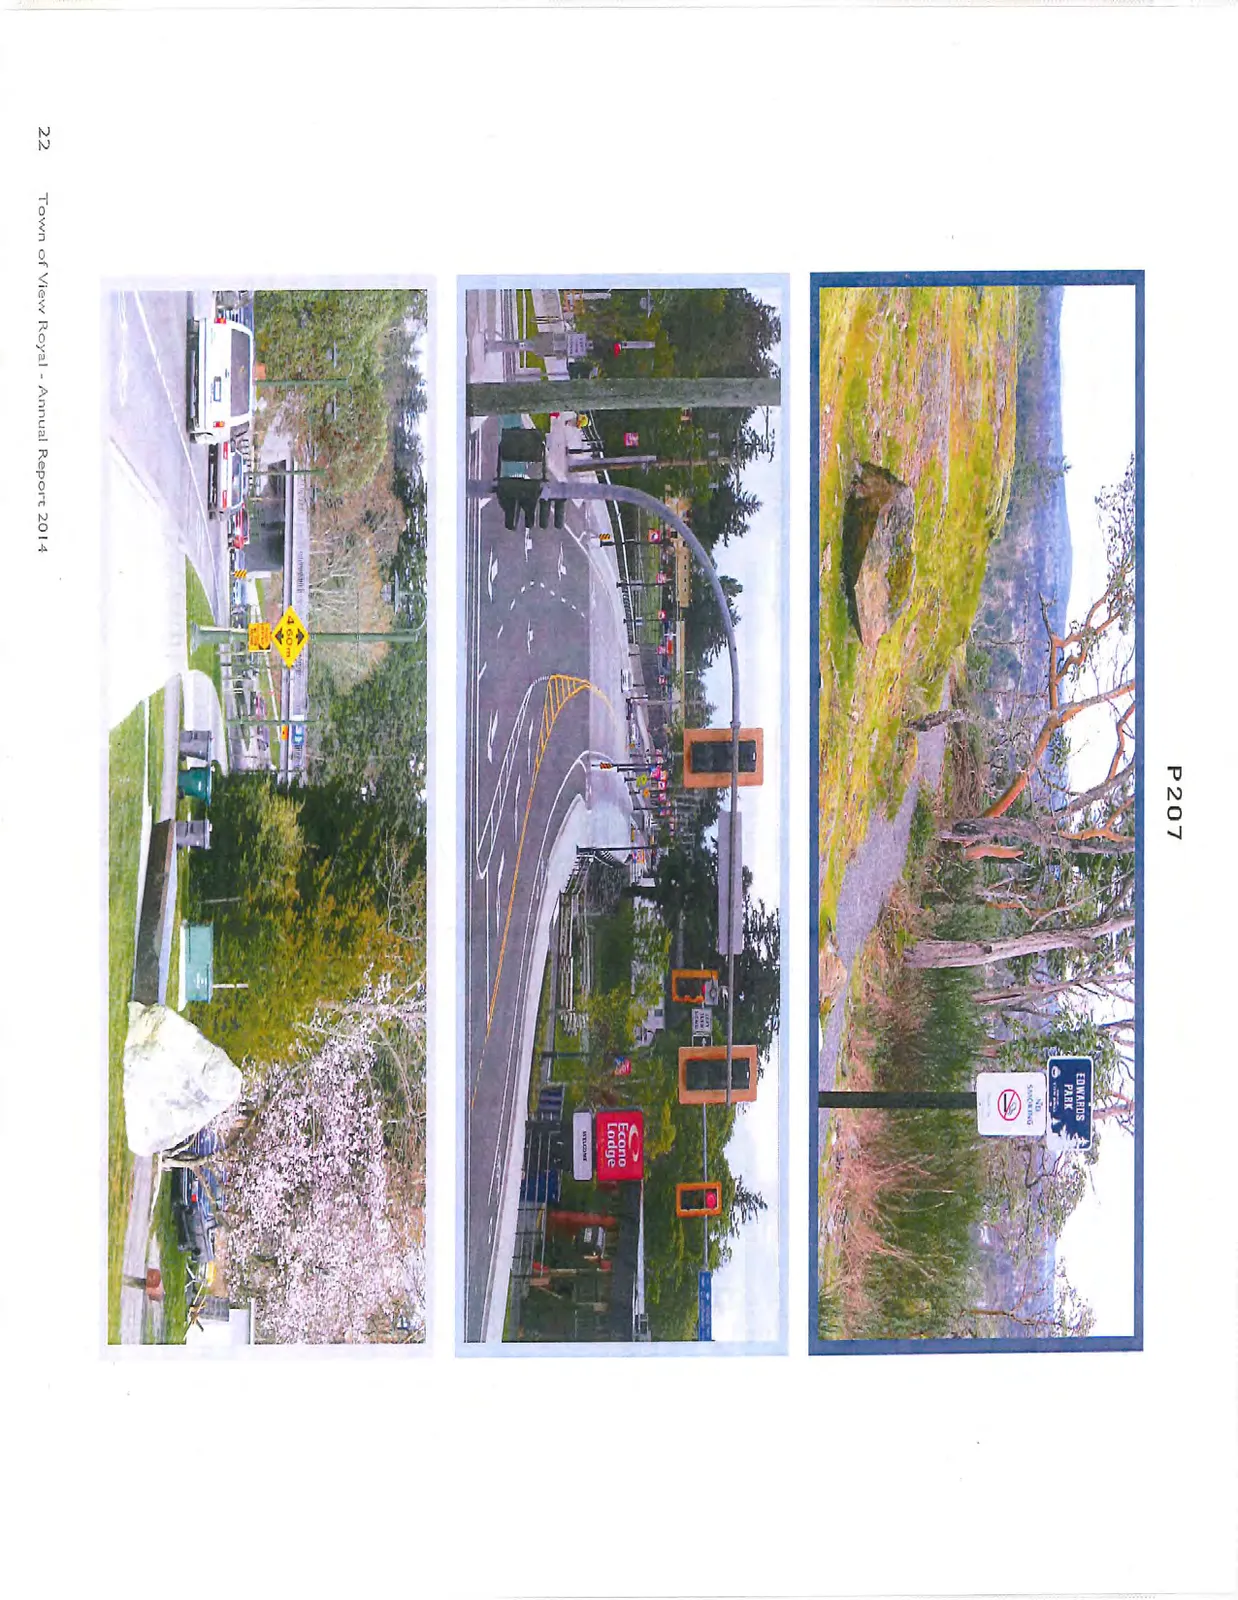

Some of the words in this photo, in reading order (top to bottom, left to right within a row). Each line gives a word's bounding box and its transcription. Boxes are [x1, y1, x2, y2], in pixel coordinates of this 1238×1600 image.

[38, 126, 50, 151] 22
[38, 192, 49, 242] Town
[38, 248, 49, 268] of
[38, 272, 49, 314] View
[36, 320, 49, 367] Royal
[38, 385, 49, 442] Annual
[36, 449, 49, 507] Report
[38, 513, 49, 553] 2014
[1167, 766, 1182, 840] P207
[1026, 1084, 1034, 1126] SMOKING
[1034, 1098, 1042, 1112] NO
[1064, 1084, 1074, 1110] PARK
[1076, 1072, 1086, 1122] EDWARDS
[605, 1122, 618, 1168] Lodge
[618, 1122, 629, 1168] Econo
